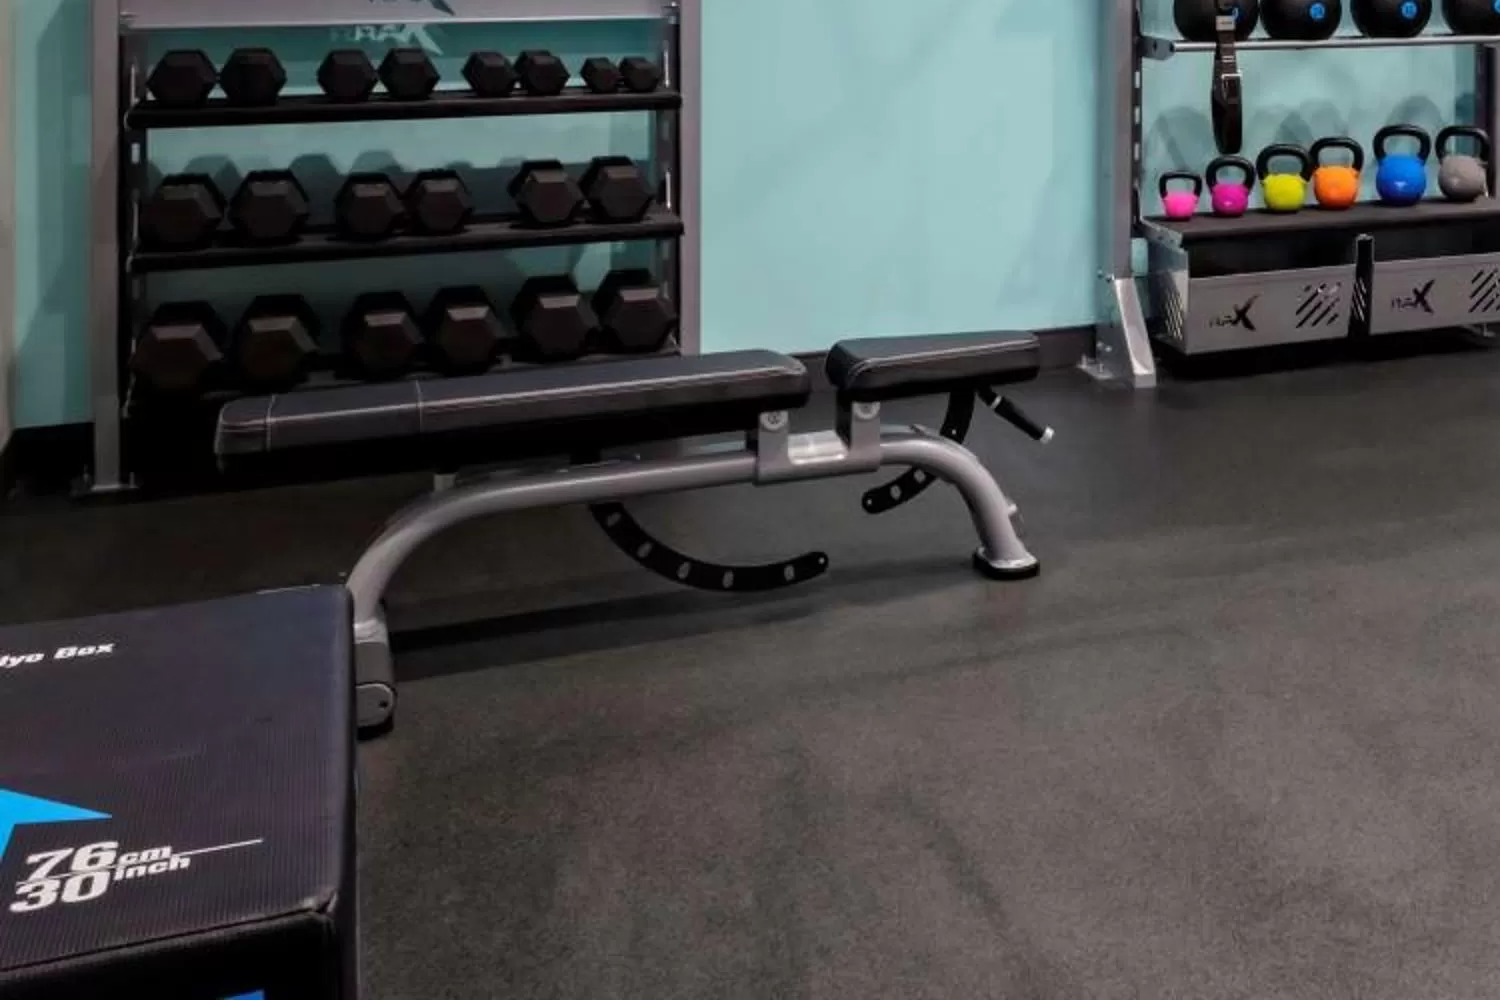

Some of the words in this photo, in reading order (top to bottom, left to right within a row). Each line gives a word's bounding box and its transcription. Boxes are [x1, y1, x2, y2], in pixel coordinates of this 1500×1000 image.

[0, 653, 45, 668] lyo
[54, 643, 115, 659] Box
[26, 841, 119, 883] 76
[117, 845, 173, 865] cm
[9, 871, 110, 912] 30
[112, 855, 191, 881] inch
